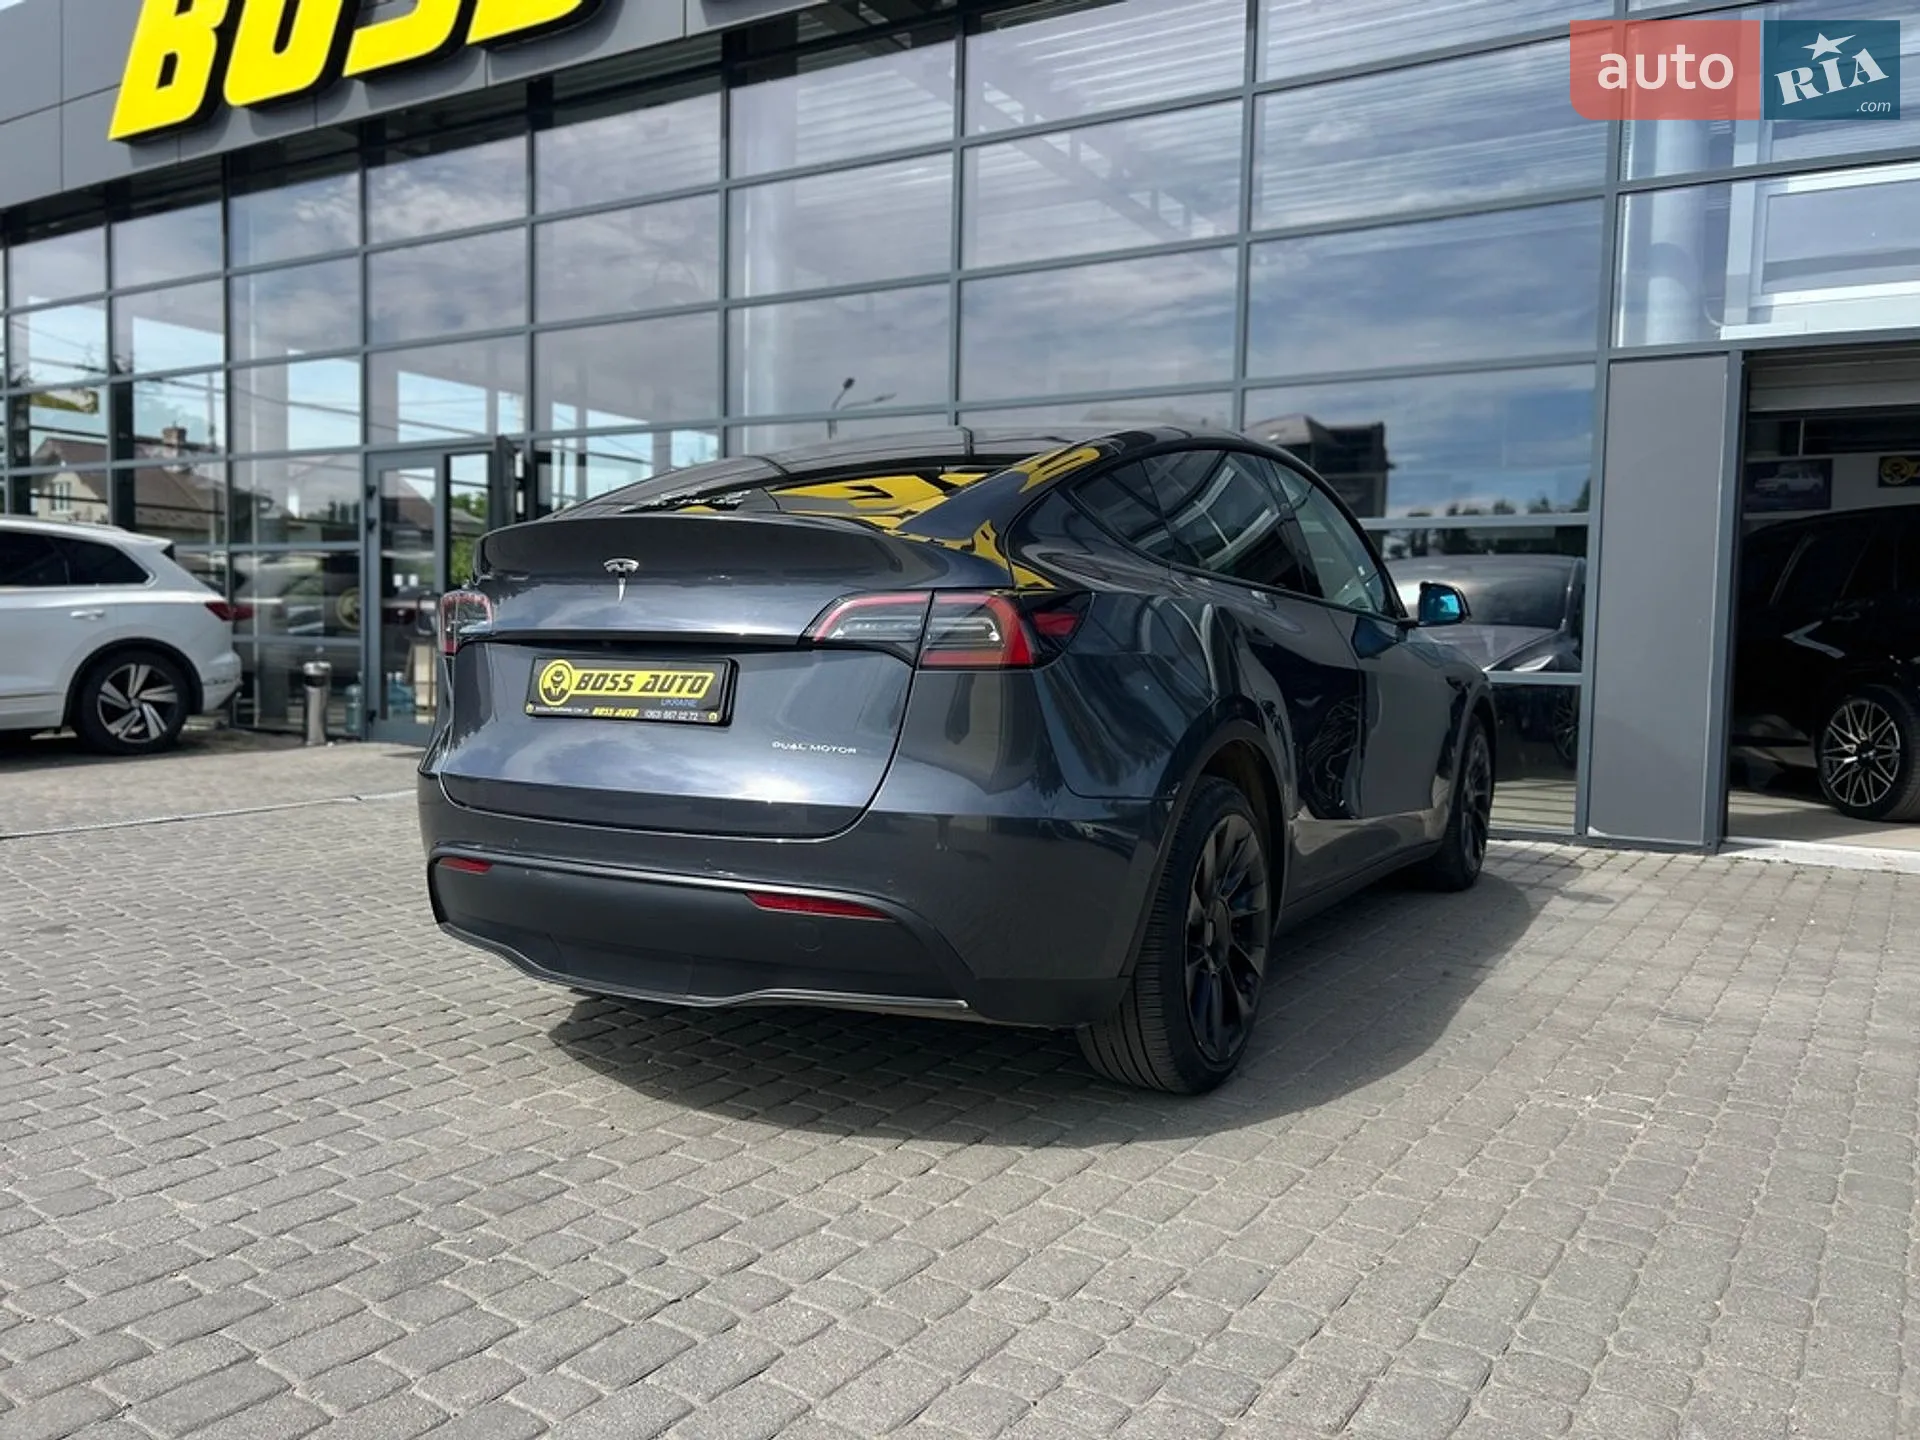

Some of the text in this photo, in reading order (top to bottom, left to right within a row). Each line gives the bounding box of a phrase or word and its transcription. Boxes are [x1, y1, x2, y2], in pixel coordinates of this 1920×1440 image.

[574, 672, 710, 694] BOSS AUTO
[772, 741, 856, 754] DUAL MOTOR
